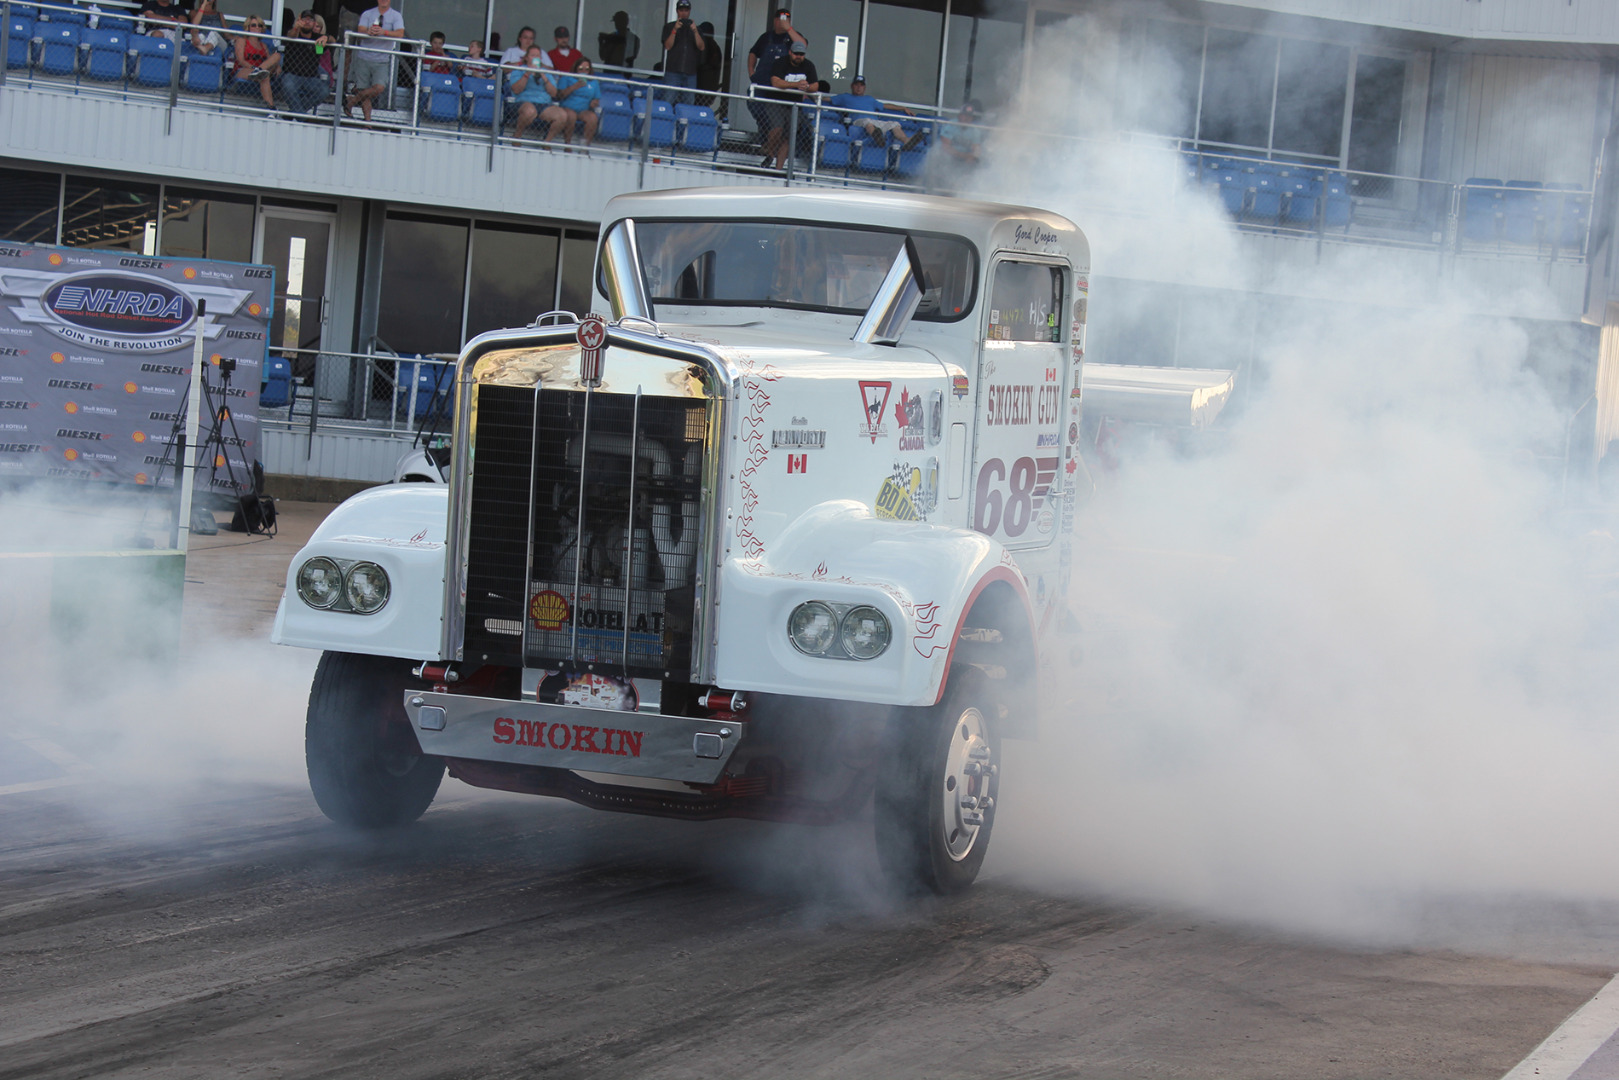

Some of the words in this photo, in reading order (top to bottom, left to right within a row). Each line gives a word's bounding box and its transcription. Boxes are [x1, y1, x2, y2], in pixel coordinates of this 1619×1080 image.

[1015, 224, 1032, 244] Gord
[1034, 226, 1057, 245] Cooper
[119, 258, 163, 270] DIESEL
[54, 286, 184, 318] NHRDA
[54, 309, 84, 317] National
[117, 313, 139, 321] Diesel
[141, 315, 182, 324] Association
[59, 328, 85, 340] JOIN
[89, 337, 110, 347] THE
[114, 337, 182, 349] REVOLUTION
[226, 330, 262, 341] DIESEL
[140, 363, 184, 376] DIESEL
[47, 378, 93, 391] DIESEL
[987, 384, 1034, 426] SMOKIN
[1038, 385, 1060, 425] GUN
[56, 428, 102, 441] DIESEL
[877, 482, 900, 512] BD
[974, 456, 1037, 538] 68
[493, 717, 645, 758] SMOKIN
